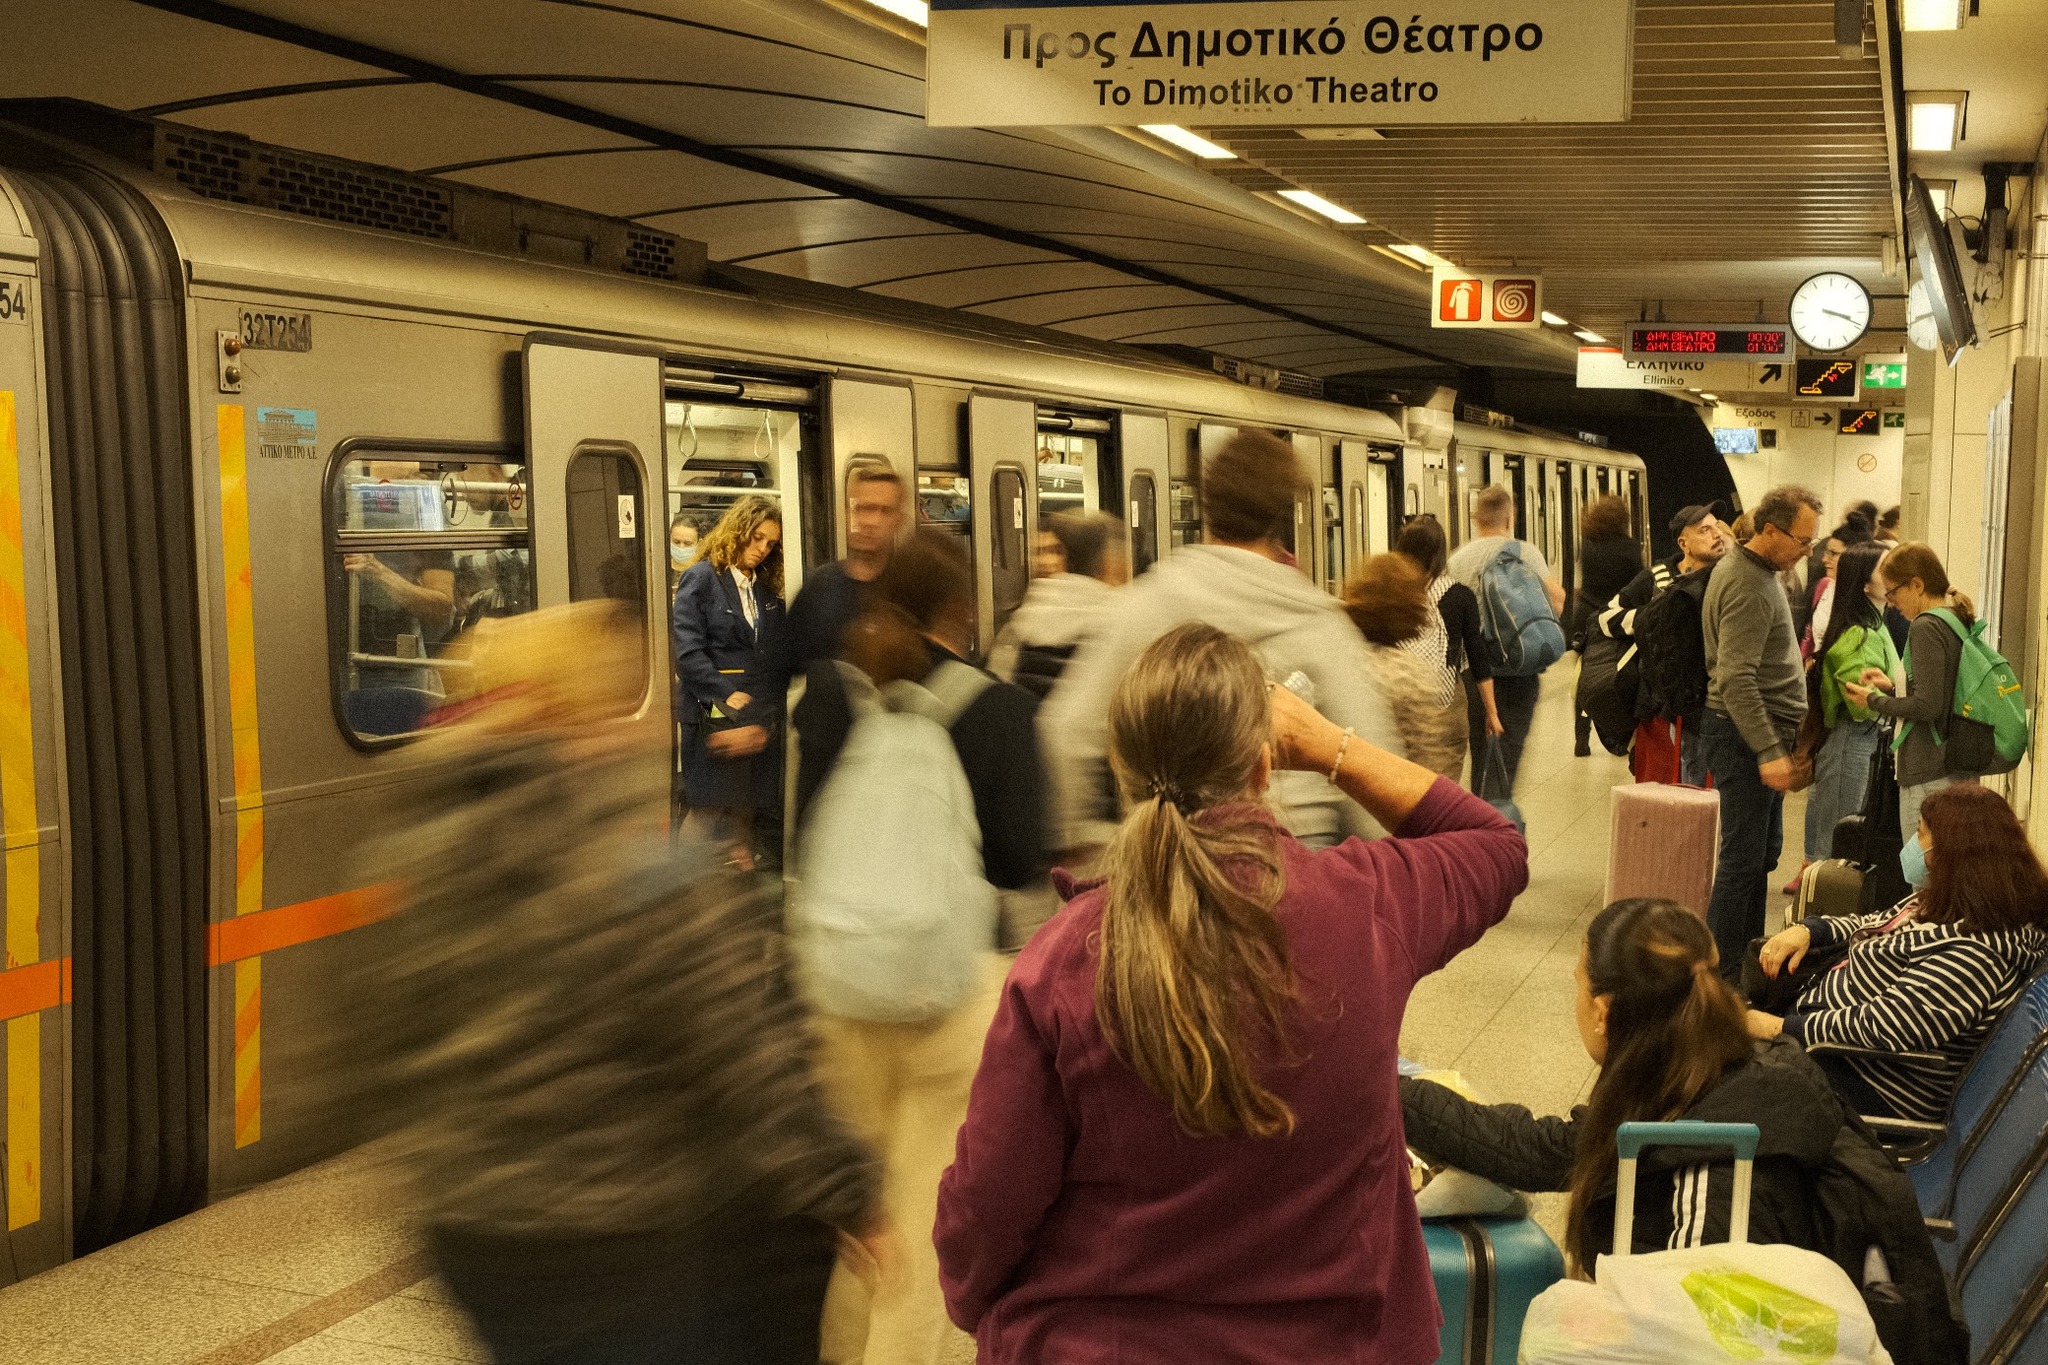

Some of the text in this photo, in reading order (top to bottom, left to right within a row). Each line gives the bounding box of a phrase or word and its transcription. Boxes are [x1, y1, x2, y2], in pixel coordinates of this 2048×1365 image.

[1003, 15, 1543, 69] Προς Δημοτικό Θέατρο
[1093, 76, 1439, 106] To Dimotiko Theatro
[243, 311, 311, 350] 32T254
[1643, 375, 1685, 386] Elliniko
[283, 444, 305, 459] ΜΕΤΡΟ
